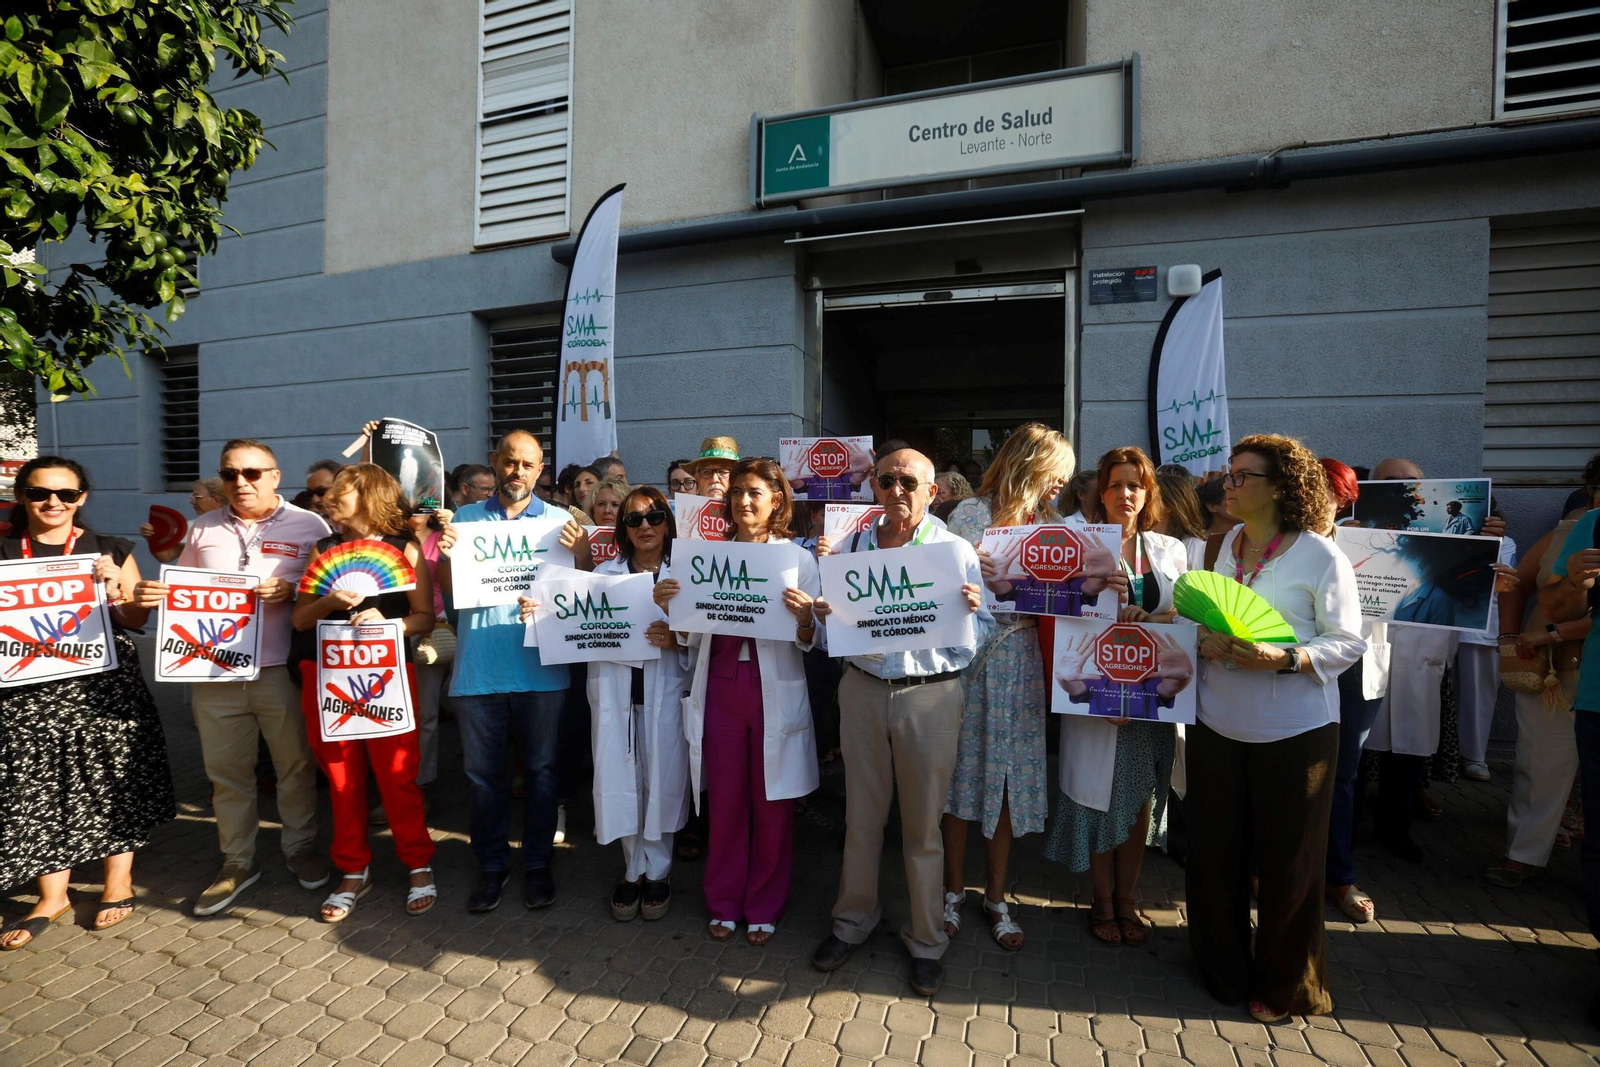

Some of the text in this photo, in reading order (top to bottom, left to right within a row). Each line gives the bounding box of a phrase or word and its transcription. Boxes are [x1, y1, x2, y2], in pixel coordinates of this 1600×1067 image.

[909, 106, 1053, 143] Centro de Salud
[960, 137, 1006, 155] Levante
[1018, 131, 1052, 147] Norte
[795, 161, 819, 170] Andalucía
[1092, 278, 1122, 286] protegida
[567, 313, 608, 336] SMA
[567, 336, 607, 348] CÓRDOBA
[819, 444, 838, 453] SAS
[812, 453, 845, 466] STOP
[597, 533, 611, 542] SA
[1038, 533, 1067, 545] SAS
[473, 533, 549, 563] SMA
[590, 542, 617, 556] STO
[1027, 545, 1076, 564] STOP
[497, 564, 539, 573] CORDO
[691, 554, 769, 591] SMA
[1029, 564, 1073, 572] AGRESIONES
[481, 573, 536, 584] SINDICATO MÉD
[845, 563, 935, 604] SMA
[0, 579, 84, 609] STOP
[503, 583, 531, 591] CÓRDO
[172, 589, 248, 611] STOP
[712, 591, 769, 604] CORDOBA
[553, 589, 630, 621] SMA
[695, 602, 766, 614] SINDICATO MÉDICO
[874, 600, 938, 615] CORDOBA
[717, 612, 755, 624] CÓRDOBA
[856, 613, 936, 628] SINDICATO MÉDICO
[29, 610, 82, 646] NO
[197, 618, 238, 647] NO
[580, 621, 632, 631] CORDOBA
[871, 626, 926, 638] DE CÓRDOBA
[564, 631, 630, 642] SINDICATO MÉDICO
[1112, 631, 1141, 644] SAS
[0, 640, 104, 659] AGRESIONES
[587, 640, 622, 649] CÓRDOBA
[161, 638, 252, 668] AGRESIONES
[325, 644, 389, 666] STOP
[1101, 644, 1151, 664] STOP
[1103, 662, 1148, 672] AGRESIONES
[347, 672, 386, 705] NO
[322, 697, 404, 721] AGRESIONES
